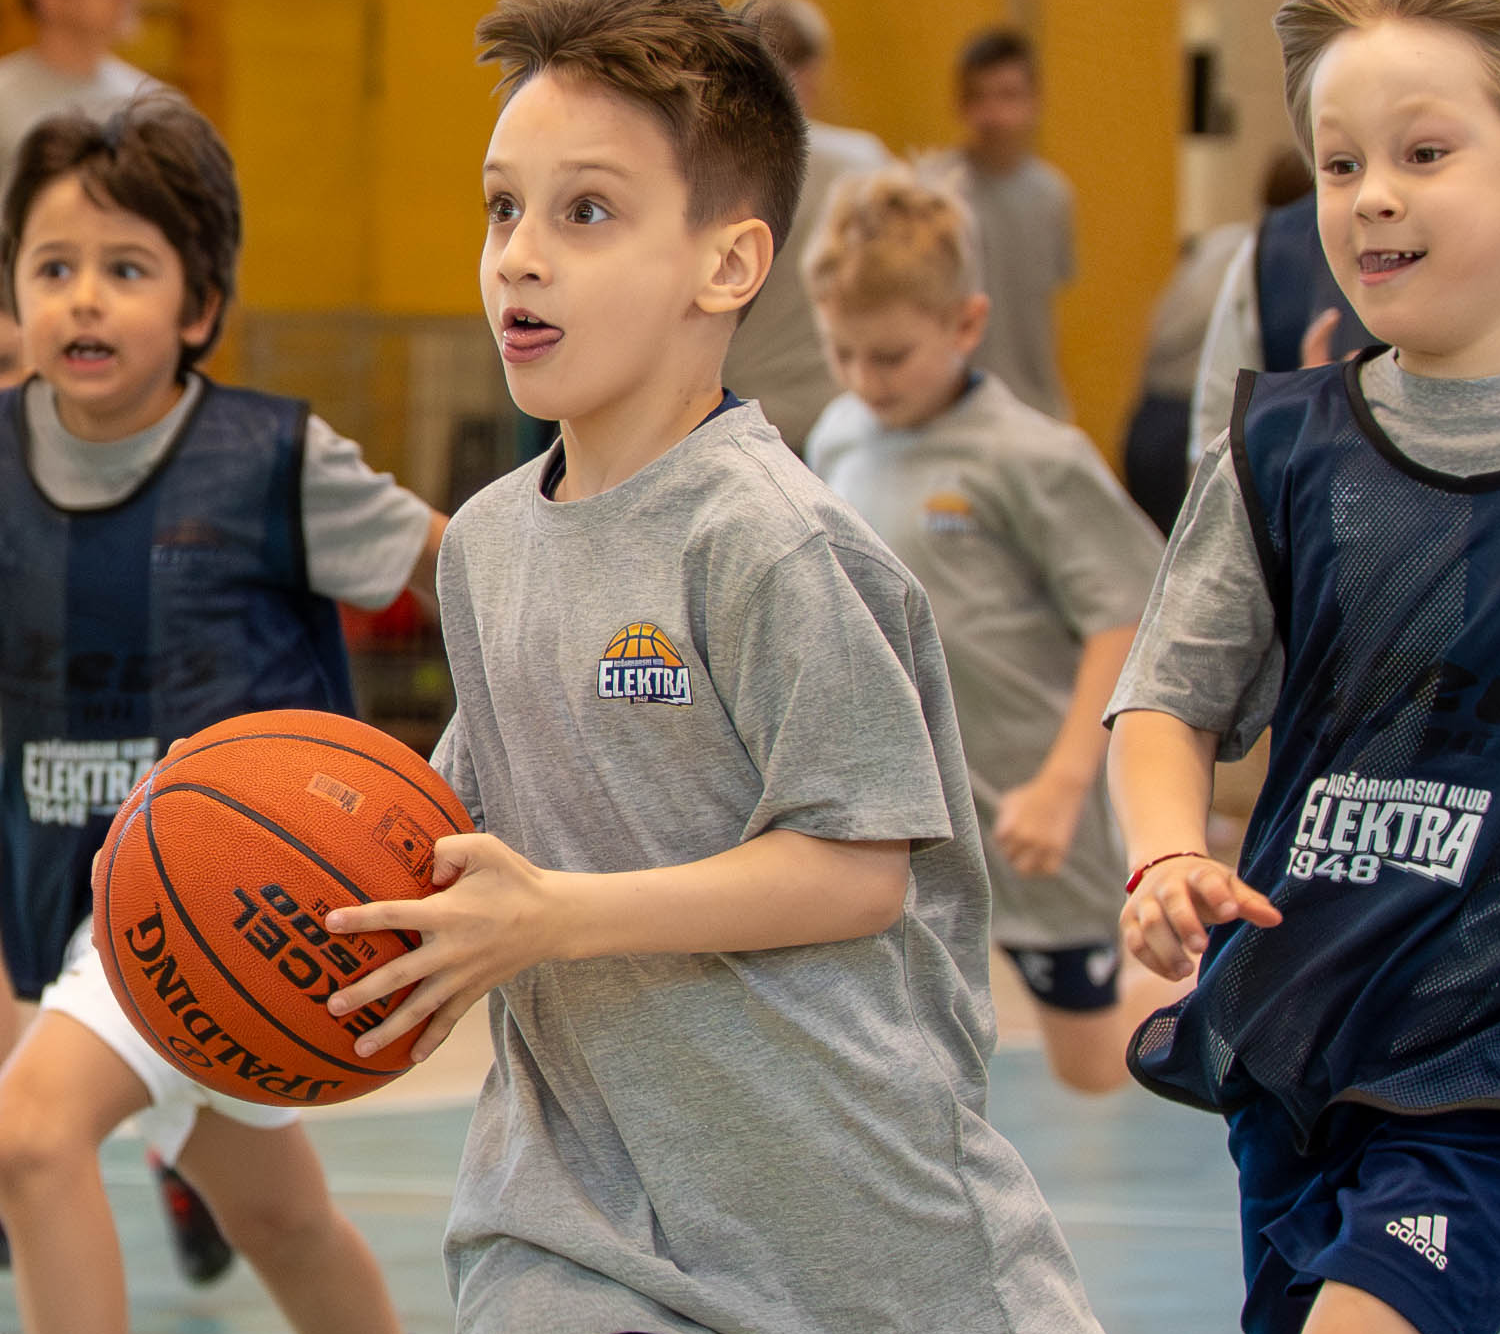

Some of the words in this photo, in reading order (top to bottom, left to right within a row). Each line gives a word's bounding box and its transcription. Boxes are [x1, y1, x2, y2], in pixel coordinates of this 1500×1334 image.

[598, 660, 693, 705] ELEKTRA
[1325, 771, 1447, 807] KOŠARKARSKI
[1445, 785, 1493, 815] KLUB
[1295, 778, 1484, 888] ELEKTRA
[1286, 847, 1382, 885] 1948
[260, 883, 361, 977] 500
[124, 912, 344, 1102] SPALDING
[1386, 1221, 1448, 1271] adidas
